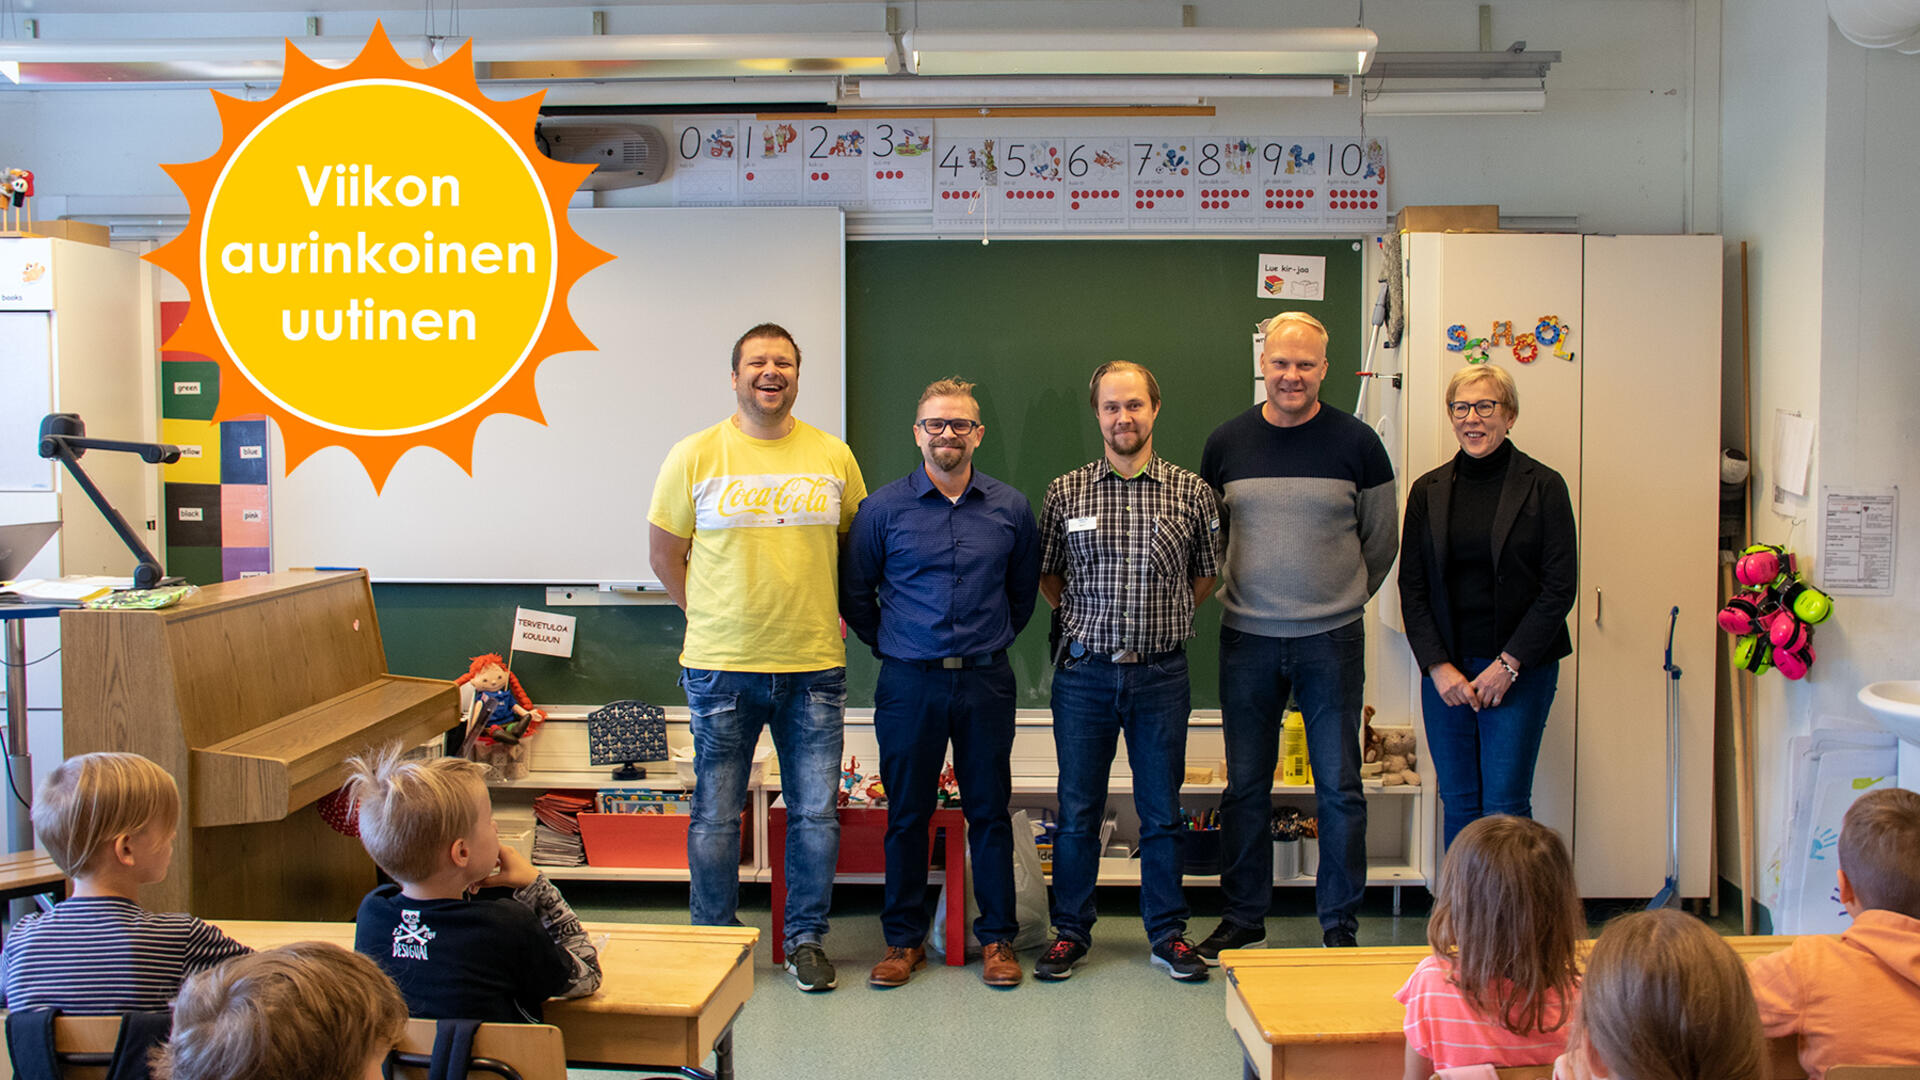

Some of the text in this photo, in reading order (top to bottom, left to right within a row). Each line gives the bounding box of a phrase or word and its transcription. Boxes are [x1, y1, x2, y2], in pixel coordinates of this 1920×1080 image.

[679, 126, 701, 160] 0
[746, 126, 752, 159] 1
[809, 125, 828, 159] 2
[872, 124, 894, 158] 3
[939, 145, 964, 177] 4
[1004, 144, 1026, 177] 5
[1068, 145, 1088, 177] 6
[1133, 143, 1153, 176] 7
[1198, 143, 1220, 176] 8
[1263, 143, 1282, 176] 9
[1327, 143, 1363, 176] 10
[1264, 264, 1279, 272] Lue
[177, 384, 198, 393] green
[178, 448, 200, 456] ellow
[243, 448, 258, 456] blue
[180, 510, 199, 518] black
[244, 511, 259, 521] pink
[518, 618, 568, 633] TERVETULOA
[522, 632, 561, 644] KOULUUN
